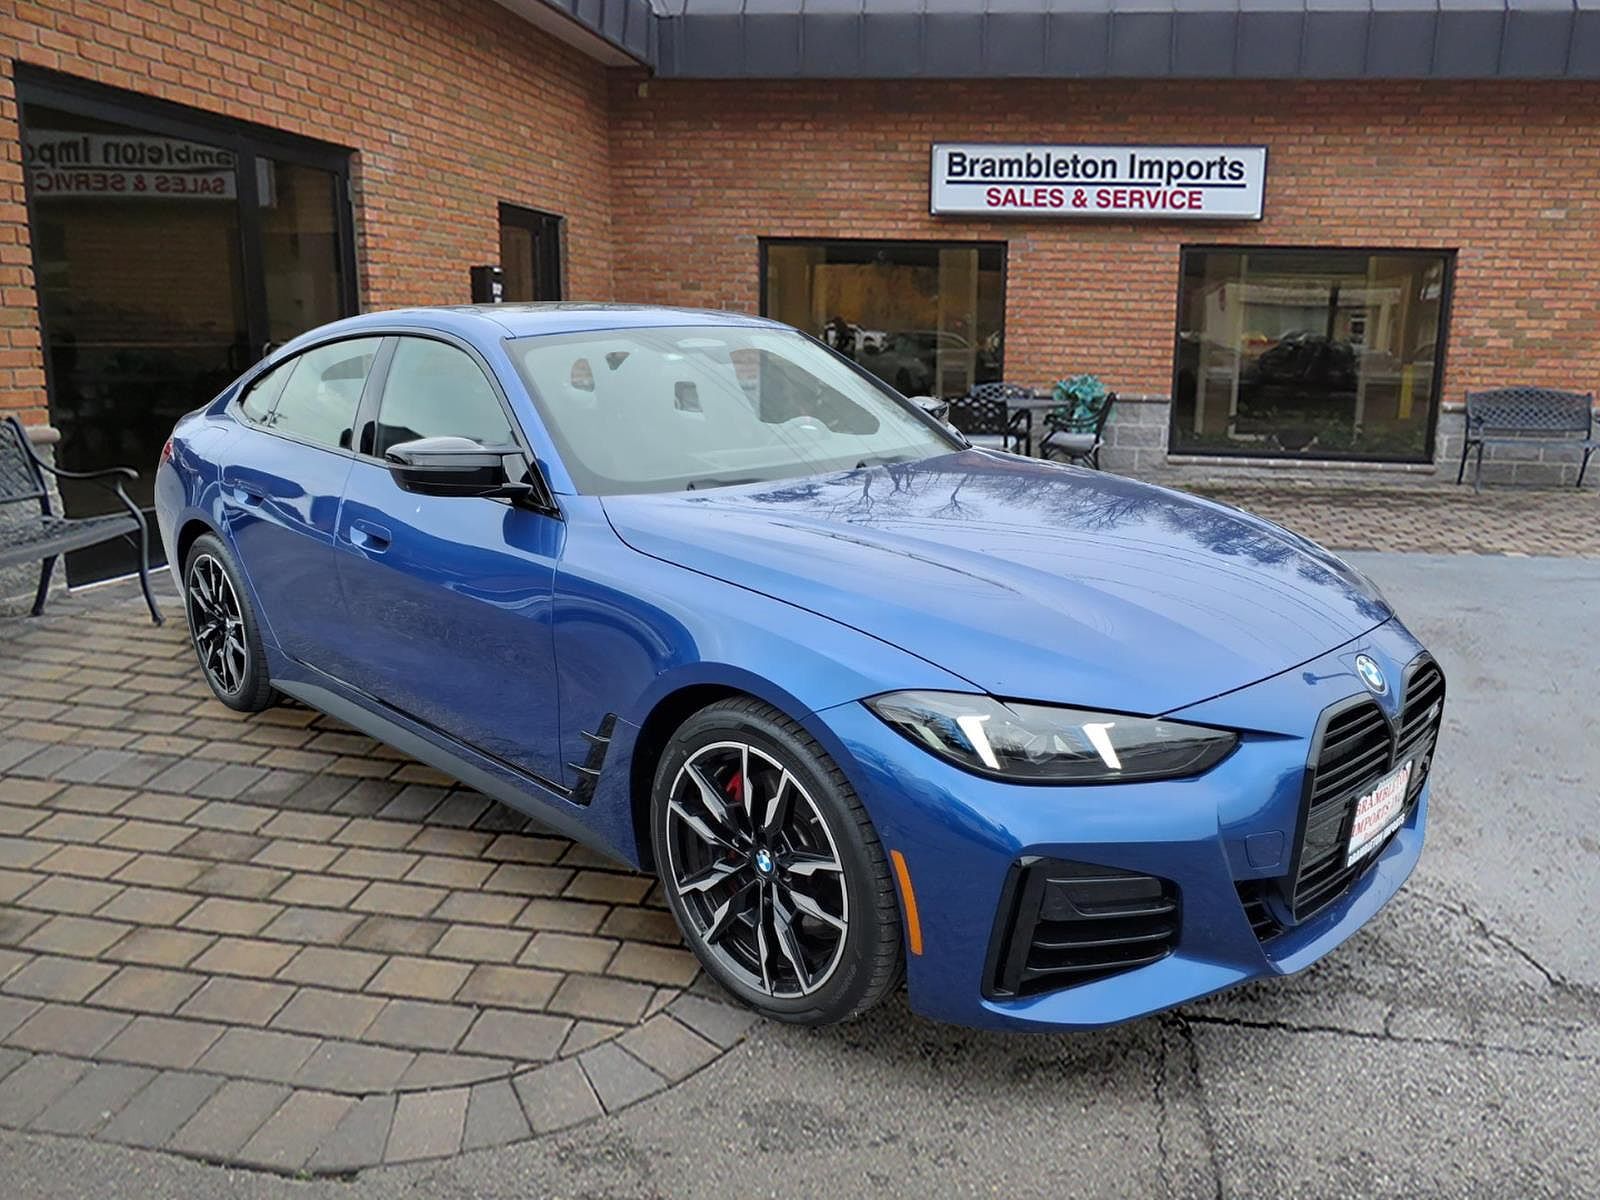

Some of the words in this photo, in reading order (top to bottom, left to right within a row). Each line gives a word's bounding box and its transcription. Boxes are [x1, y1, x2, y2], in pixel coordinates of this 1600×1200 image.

[948, 152, 1117, 178] Brambleton
[1129, 154, 1245, 187] Imports
[986, 188, 1064, 208] SALES
[1071, 189, 1088, 208] &
[1096, 190, 1202, 209] SERVICE
